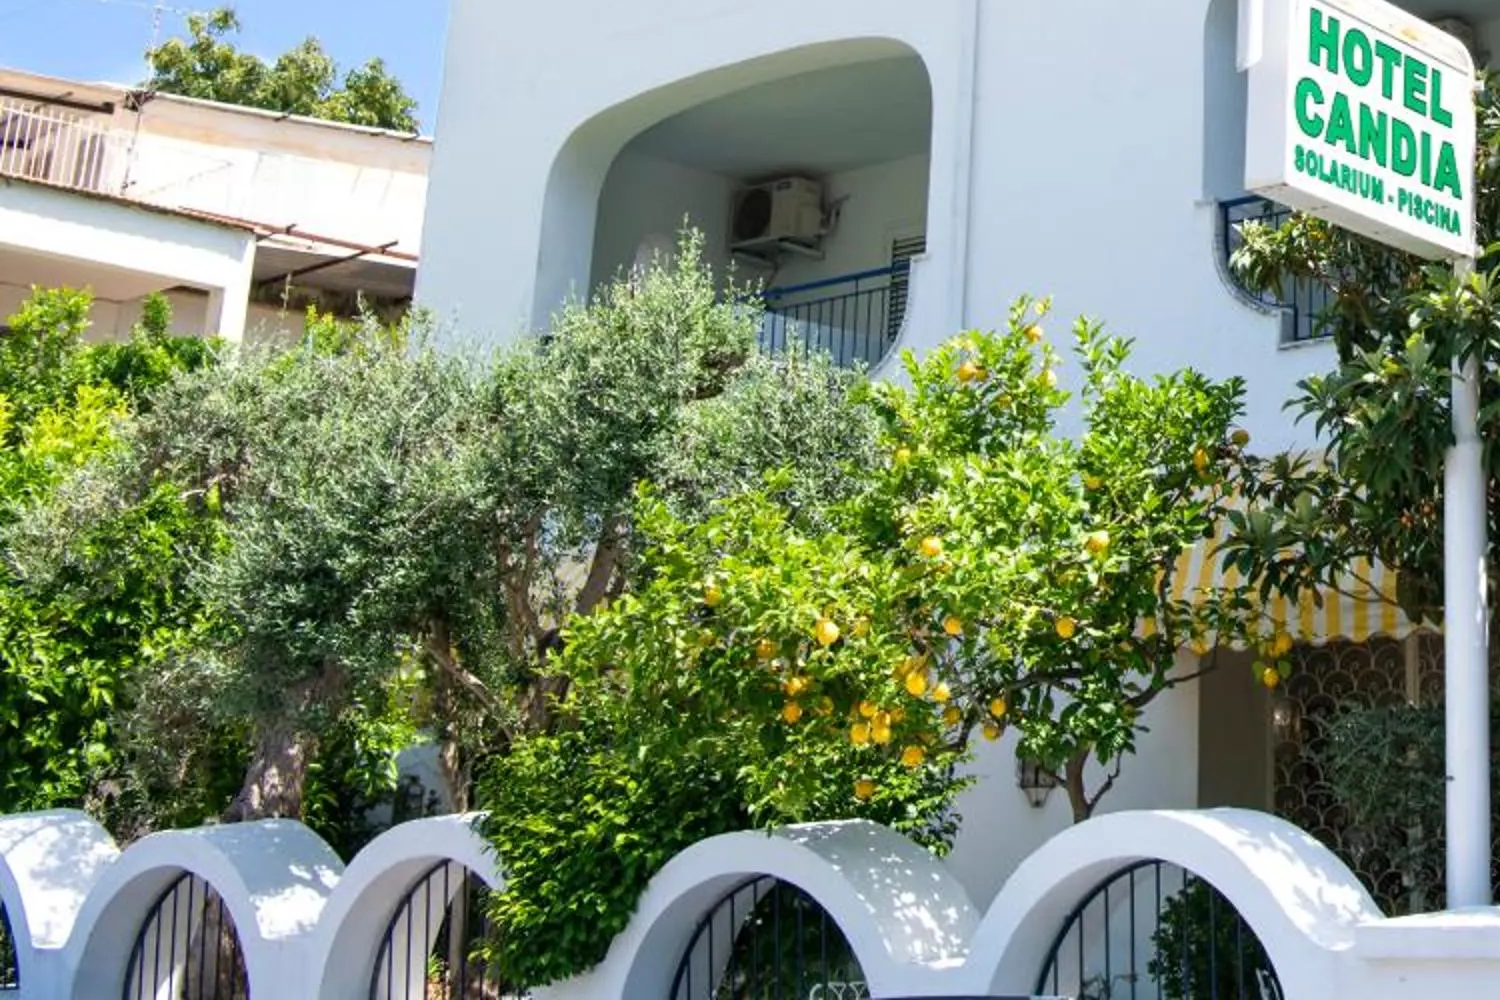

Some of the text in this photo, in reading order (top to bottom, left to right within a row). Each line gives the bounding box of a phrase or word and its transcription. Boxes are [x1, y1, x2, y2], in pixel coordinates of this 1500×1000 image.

[1308, 7, 1453, 129] HOTEL
[1294, 77, 1462, 200] CANDIA
[1294, 144, 1384, 204] SOLARIUM
[1398, 187, 1461, 236] PISCINA
